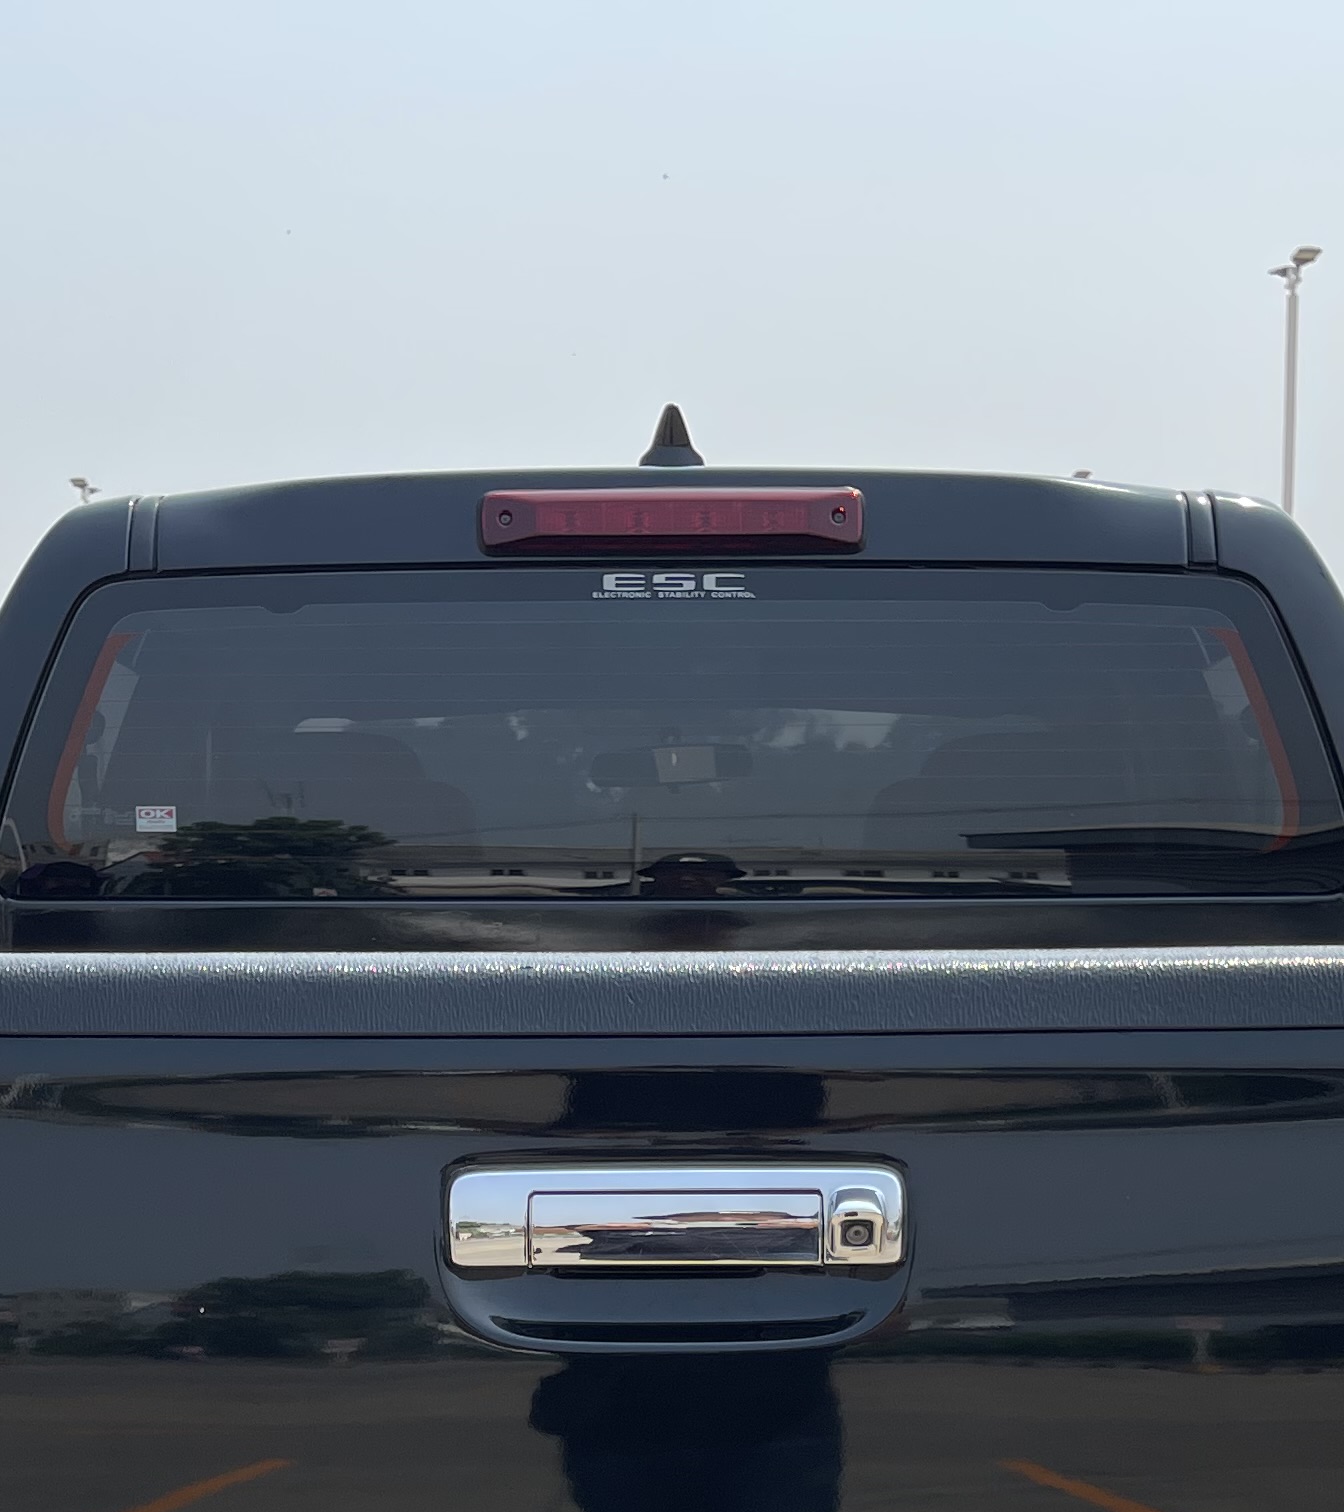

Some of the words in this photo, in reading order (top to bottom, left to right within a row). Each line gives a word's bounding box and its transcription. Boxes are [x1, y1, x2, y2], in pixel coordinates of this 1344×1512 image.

[602, 572, 745, 591] ESC
[592, 591, 651, 599] ELECTRONIC
[658, 591, 706, 599] STABILITY
[711, 591, 756, 599] CONTROL
[140, 809, 172, 818] OK
